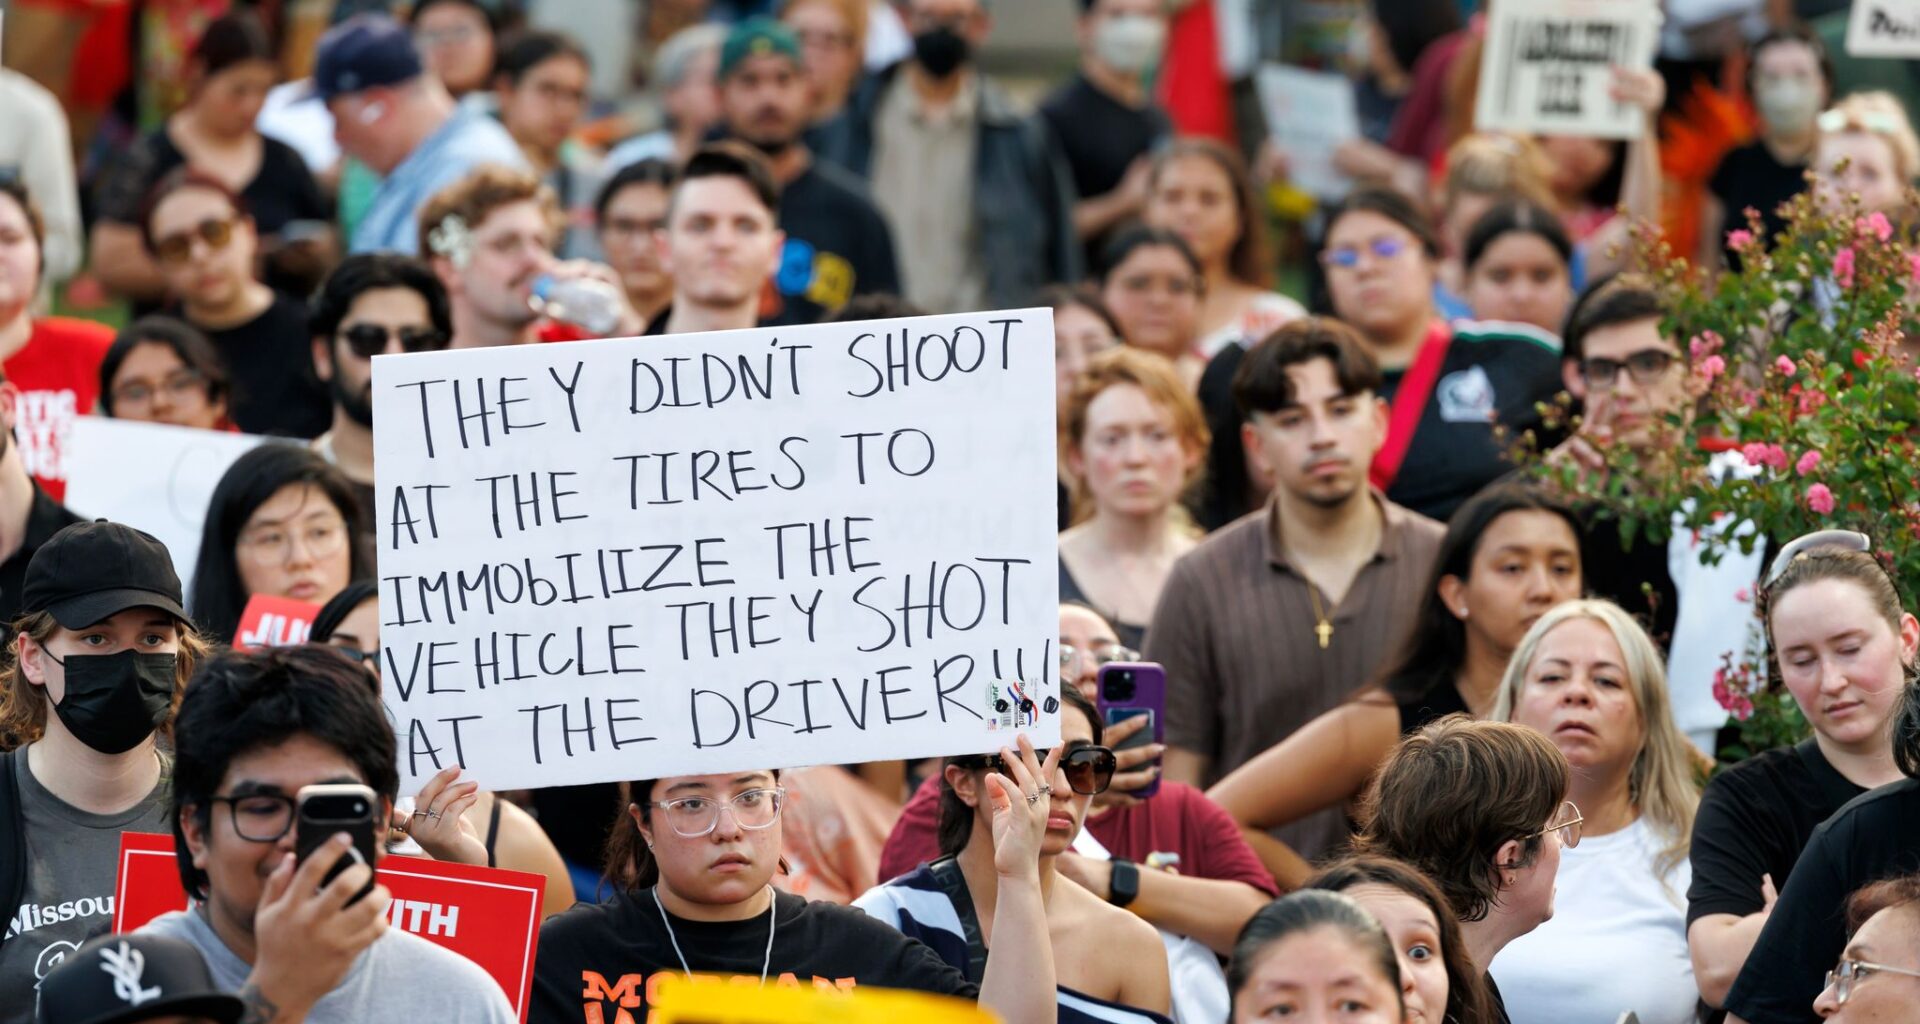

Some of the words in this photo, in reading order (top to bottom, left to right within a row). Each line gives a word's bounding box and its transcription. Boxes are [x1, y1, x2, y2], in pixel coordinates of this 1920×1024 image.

[395, 361, 584, 459] THEY
[629, 337, 813, 415] DIDN'T
[847, 318, 1023, 398] SHOOT
[390, 484, 451, 550] AT
[475, 471, 589, 539] THE
[613, 436, 809, 510] TIRES
[840, 428, 935, 485] TO
[763, 516, 881, 580] THE
[385, 624, 646, 703] VEHICLE
[665, 588, 823, 661] THEY
[852, 557, 1032, 653] SHOT
[408, 715, 483, 777] AT
[517, 696, 657, 765] THE
[581, 970, 857, 1008] MOAN
